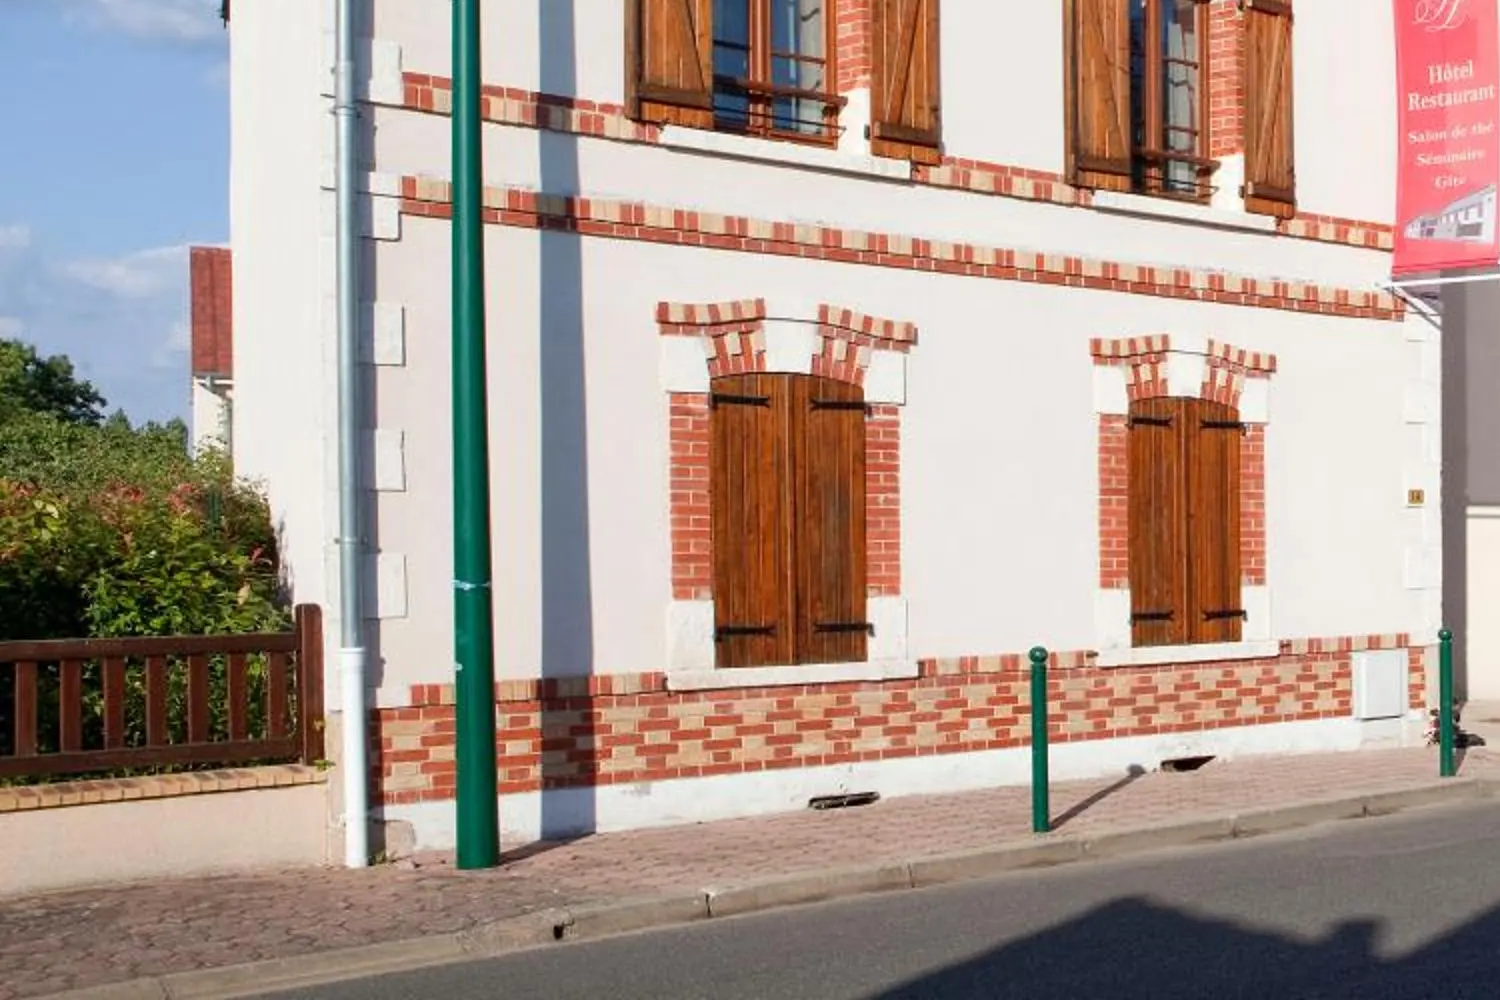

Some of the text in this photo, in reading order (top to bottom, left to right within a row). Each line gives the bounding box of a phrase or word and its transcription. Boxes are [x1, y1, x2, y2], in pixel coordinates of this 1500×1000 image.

[1428, 59, 1473, 84] Hôtel
[1407, 84, 1495, 111] Restaurant
[1408, 119, 1495, 144] Salon de thé
